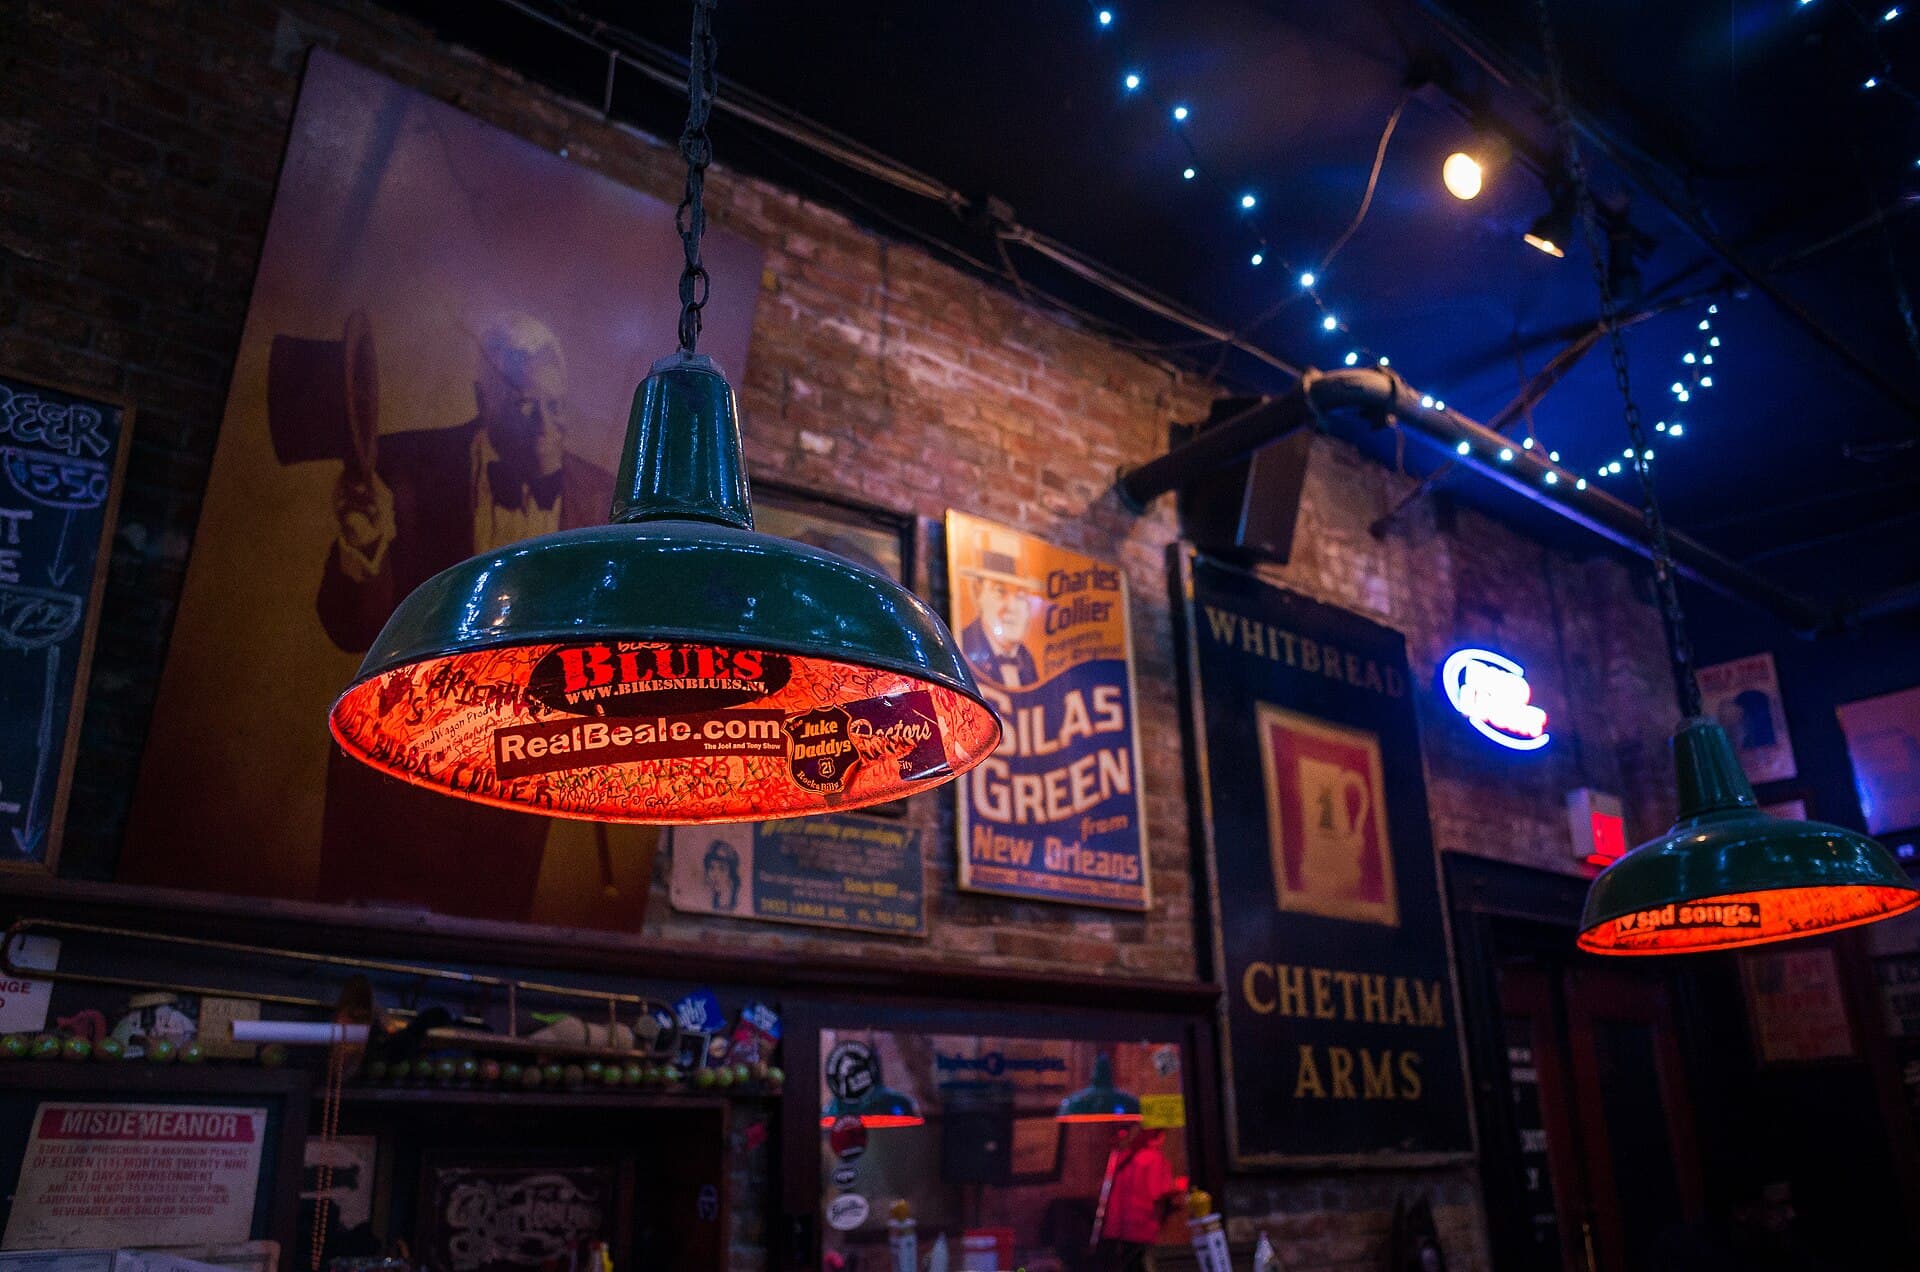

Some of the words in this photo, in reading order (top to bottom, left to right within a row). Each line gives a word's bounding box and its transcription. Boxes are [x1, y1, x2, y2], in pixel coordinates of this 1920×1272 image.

[1047, 564, 1120, 599] Charles
[1045, 595, 1113, 635] Collier
[557, 645, 764, 693] BLUES
[1204, 605, 1404, 698] WHITBREAD
[565, 678, 769, 705] WWW.BIKESNBLUES.NL
[976, 682, 1124, 757] SILAS
[763, 742, 781, 750] Show
[794, 738, 851, 761] Daddys
[820, 762, 832, 775] 21
[973, 748, 1130, 824] GREEN
[1080, 815, 1129, 842] from
[972, 824, 1034, 866] New
[1044, 836, 1139, 881] Orleans
[1637, 904, 1675, 929] sad
[1679, 904, 1760, 927] songs.
[1242, 961, 1445, 1028] CHETHAM
[1294, 1044, 1422, 1101] ARMS
[60, 1111, 238, 1138] MISDEMEANOR
[51, 1157, 94, 1168] ELEVEN
